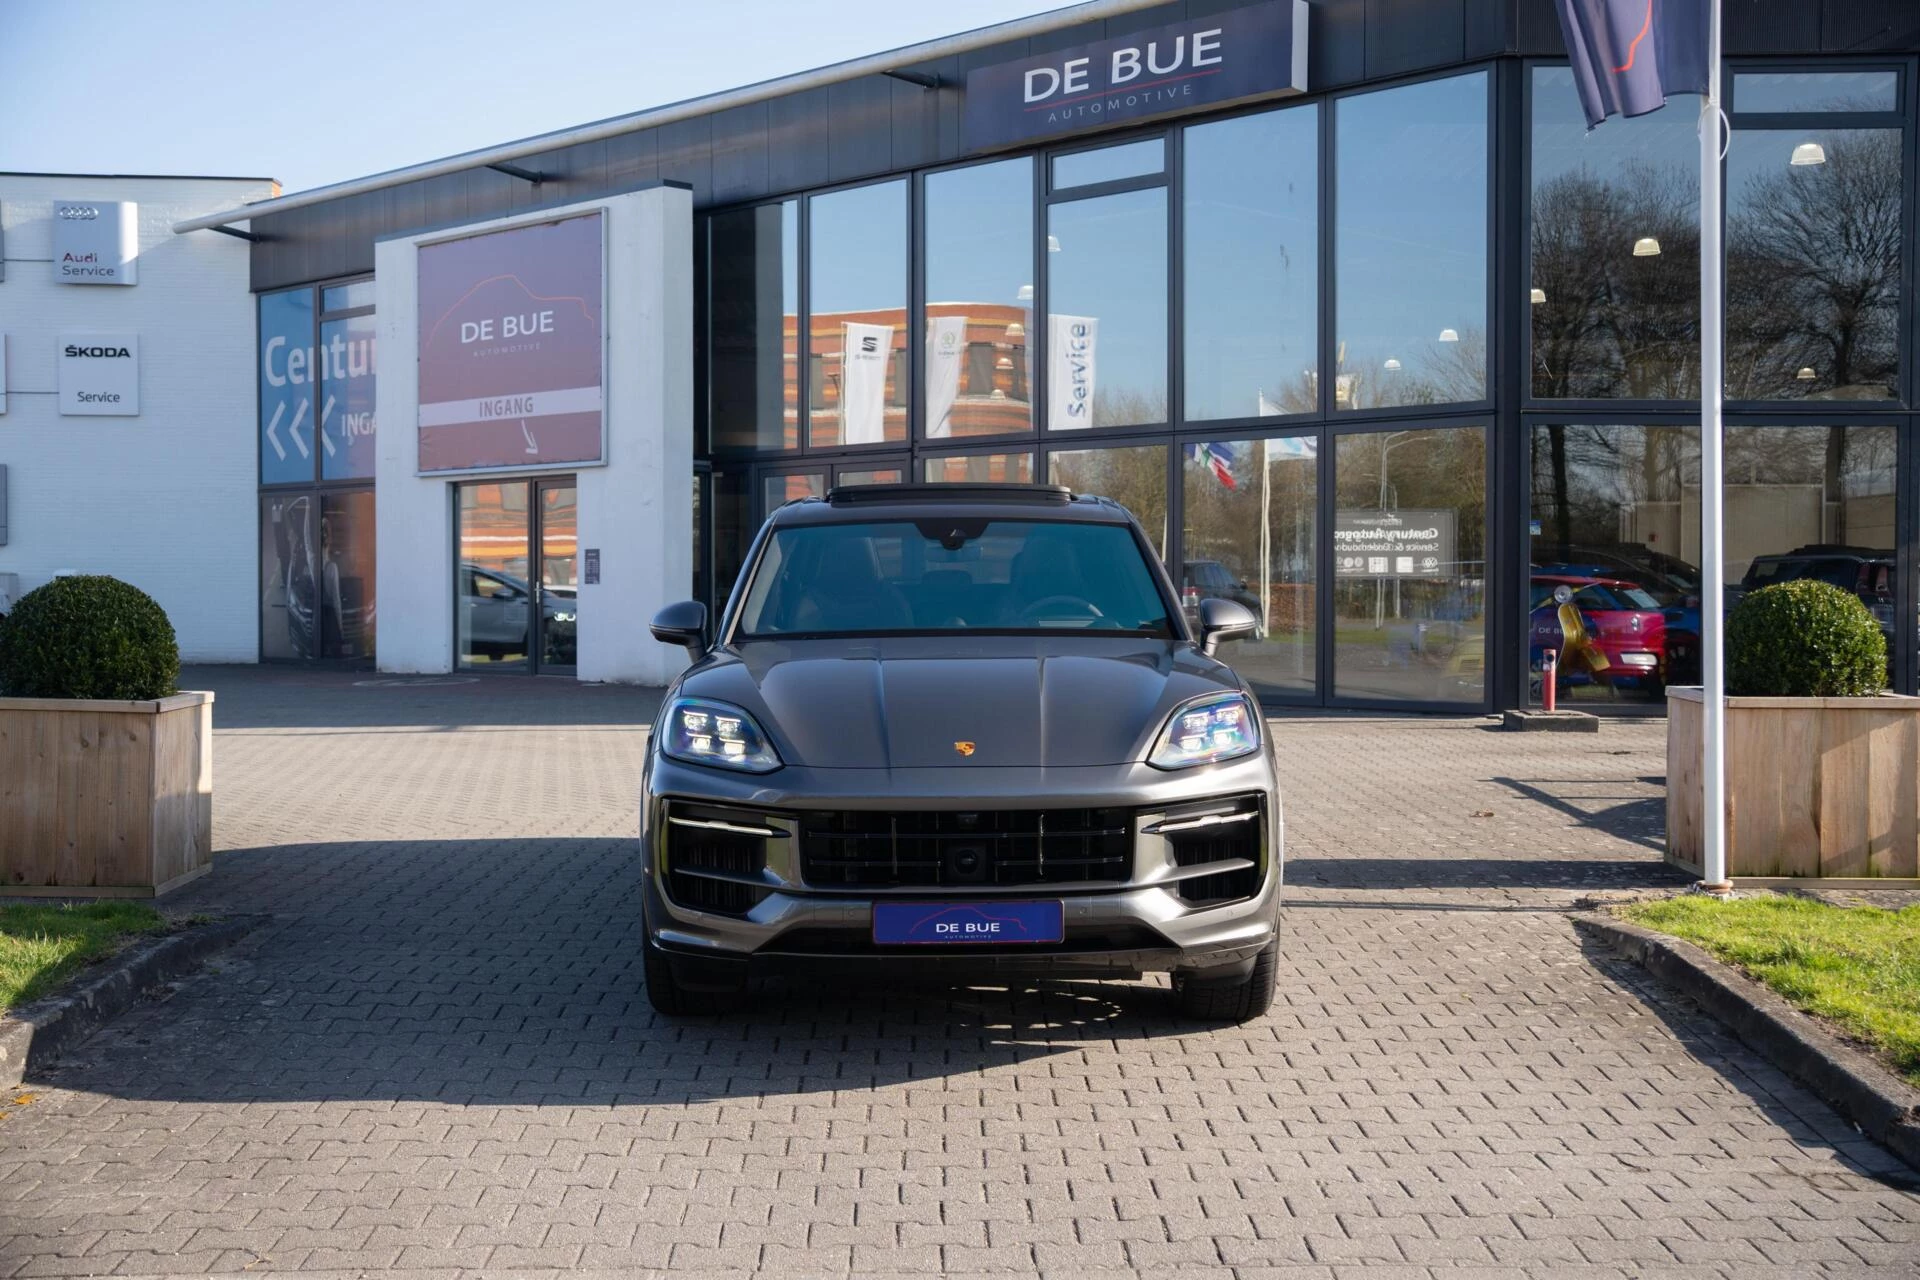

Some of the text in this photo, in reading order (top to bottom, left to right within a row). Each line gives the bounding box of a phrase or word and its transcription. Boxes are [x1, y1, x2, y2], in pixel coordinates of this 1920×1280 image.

[1024, 28, 1223, 103] DE BUE
[1048, 84, 1193, 123] AUTOMOTIVE
[63, 252, 98, 262] Audi
[62, 265, 115, 276] Service
[461, 310, 554, 343] DE BUE
[65, 344, 131, 358] ŠKODA
[1065, 323, 1087, 418] Service
[77, 391, 121, 403] Service
[479, 397, 534, 418] INGANG
[936, 922, 1000, 933] DE BUE
